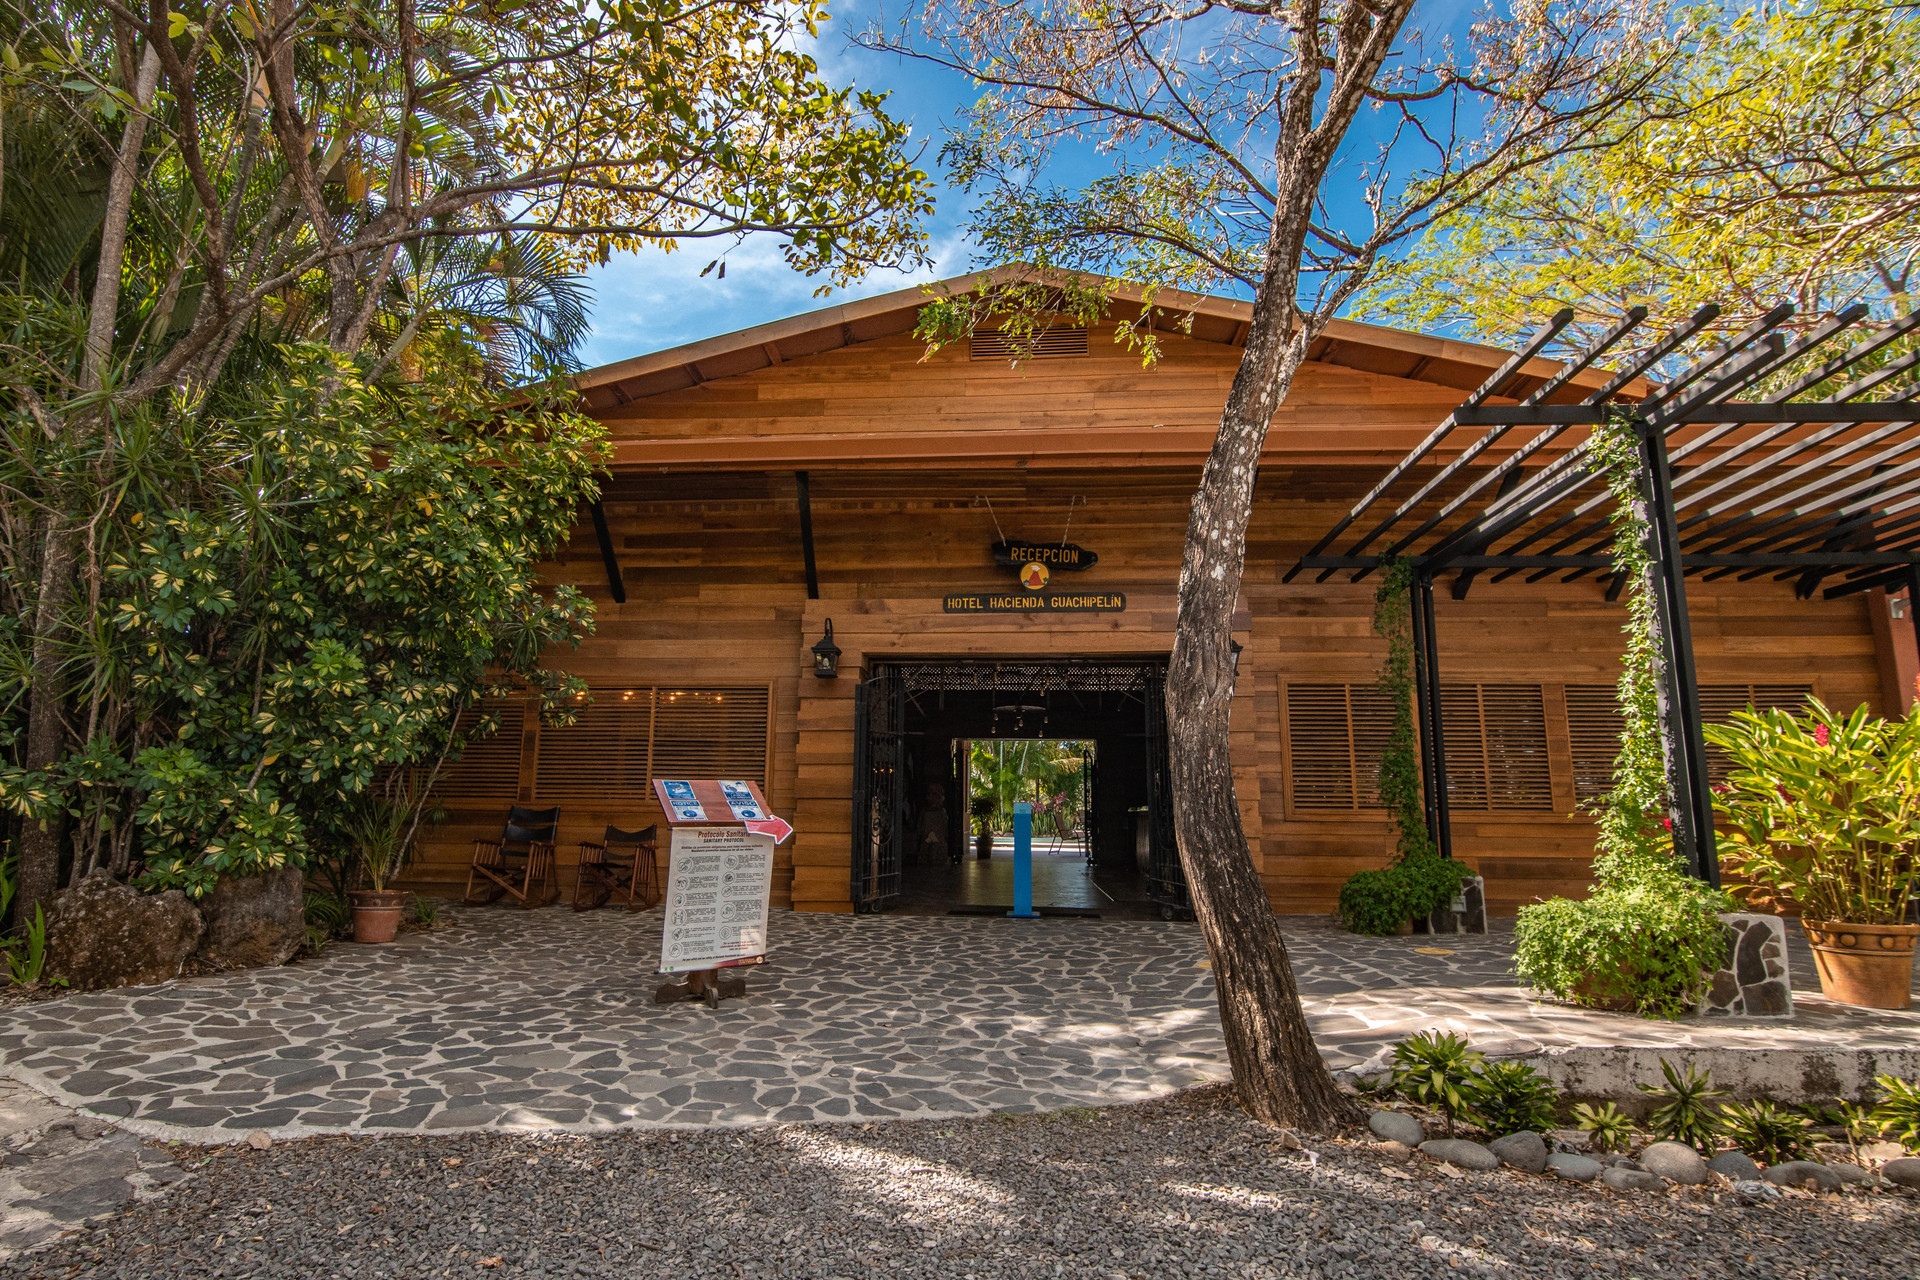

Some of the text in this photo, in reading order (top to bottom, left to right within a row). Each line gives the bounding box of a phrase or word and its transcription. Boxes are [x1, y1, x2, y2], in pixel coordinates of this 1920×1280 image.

[1011, 547, 1079, 564] RECEPCION
[947, 597, 983, 609] HOTEL
[990, 596, 1045, 608] HACIENDA
